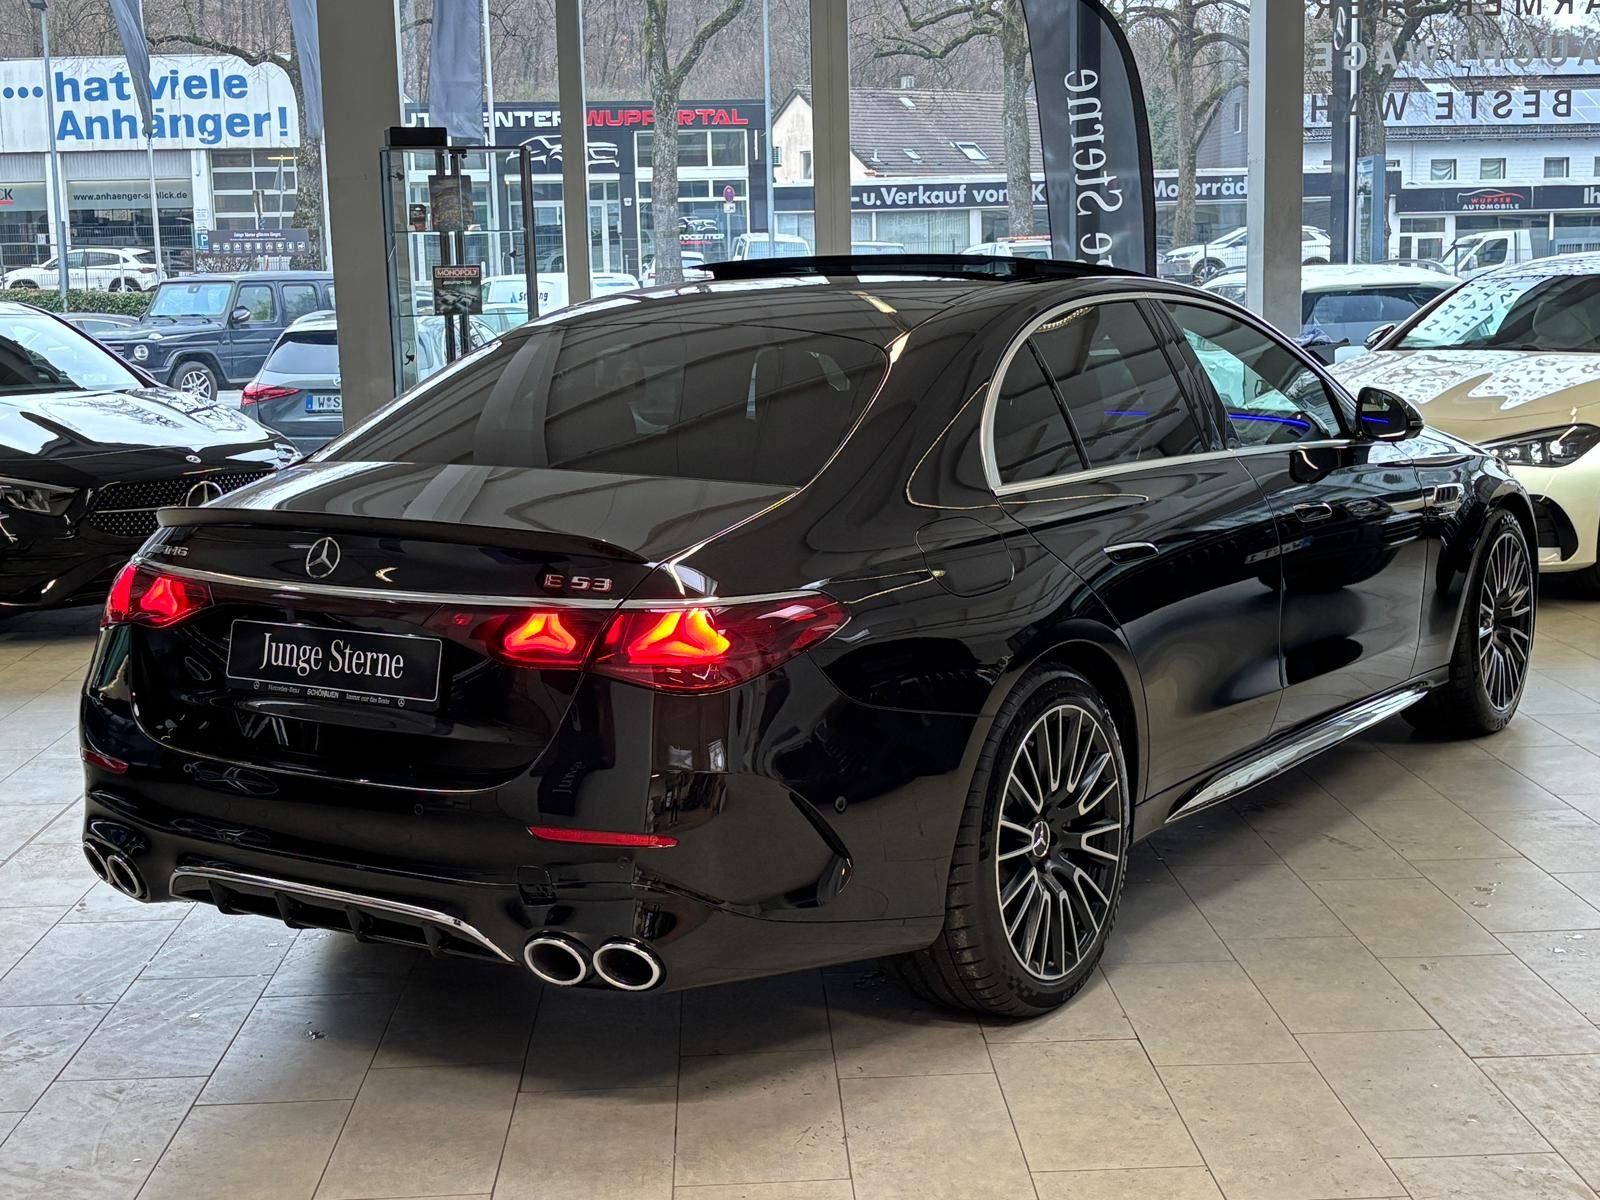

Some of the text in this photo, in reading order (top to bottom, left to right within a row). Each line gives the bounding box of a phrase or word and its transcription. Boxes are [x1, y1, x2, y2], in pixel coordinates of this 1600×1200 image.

[55, 71, 130, 102] hat
[150, 68, 248, 101] viele
[586, 109, 749, 127] WUPPRTAL
[436, 267, 478, 278] MONOPOLY
[543, 574, 613, 592] E 53
[258, 632, 404, 679] Junge Sterne
